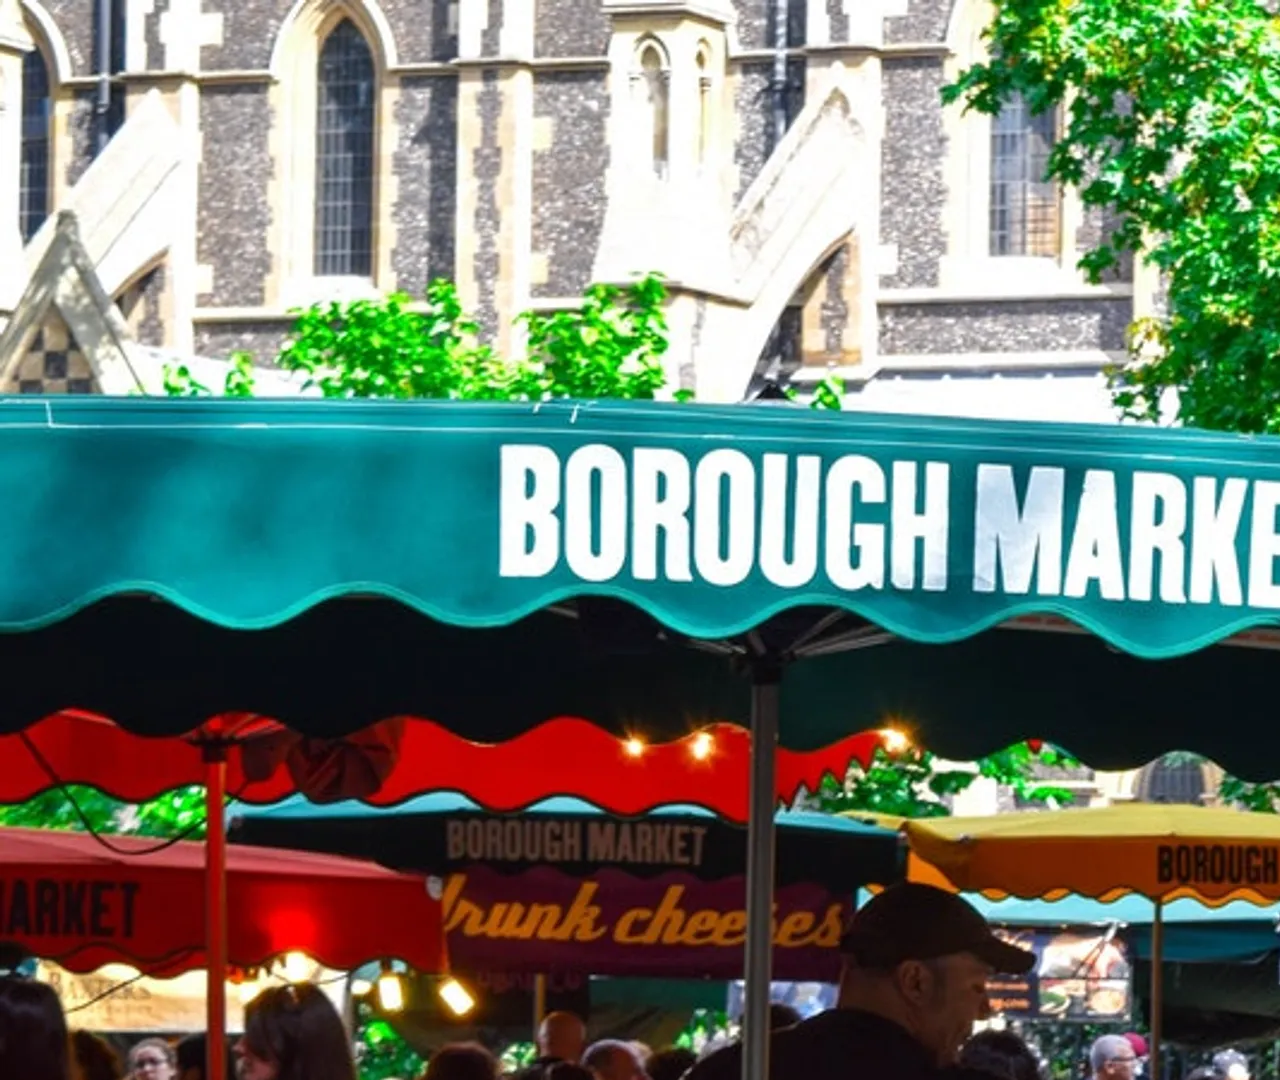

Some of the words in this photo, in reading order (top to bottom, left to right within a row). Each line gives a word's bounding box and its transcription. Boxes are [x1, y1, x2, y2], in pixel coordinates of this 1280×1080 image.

[499, 443, 949, 592] BOROUGH
[445, 819, 582, 862] BOROUGH
[586, 821, 708, 866] MARKET
[1157, 844, 1278, 885] BOROUGH
[0, 878, 140, 938] ARKET
[613, 883, 845, 948] cheees
